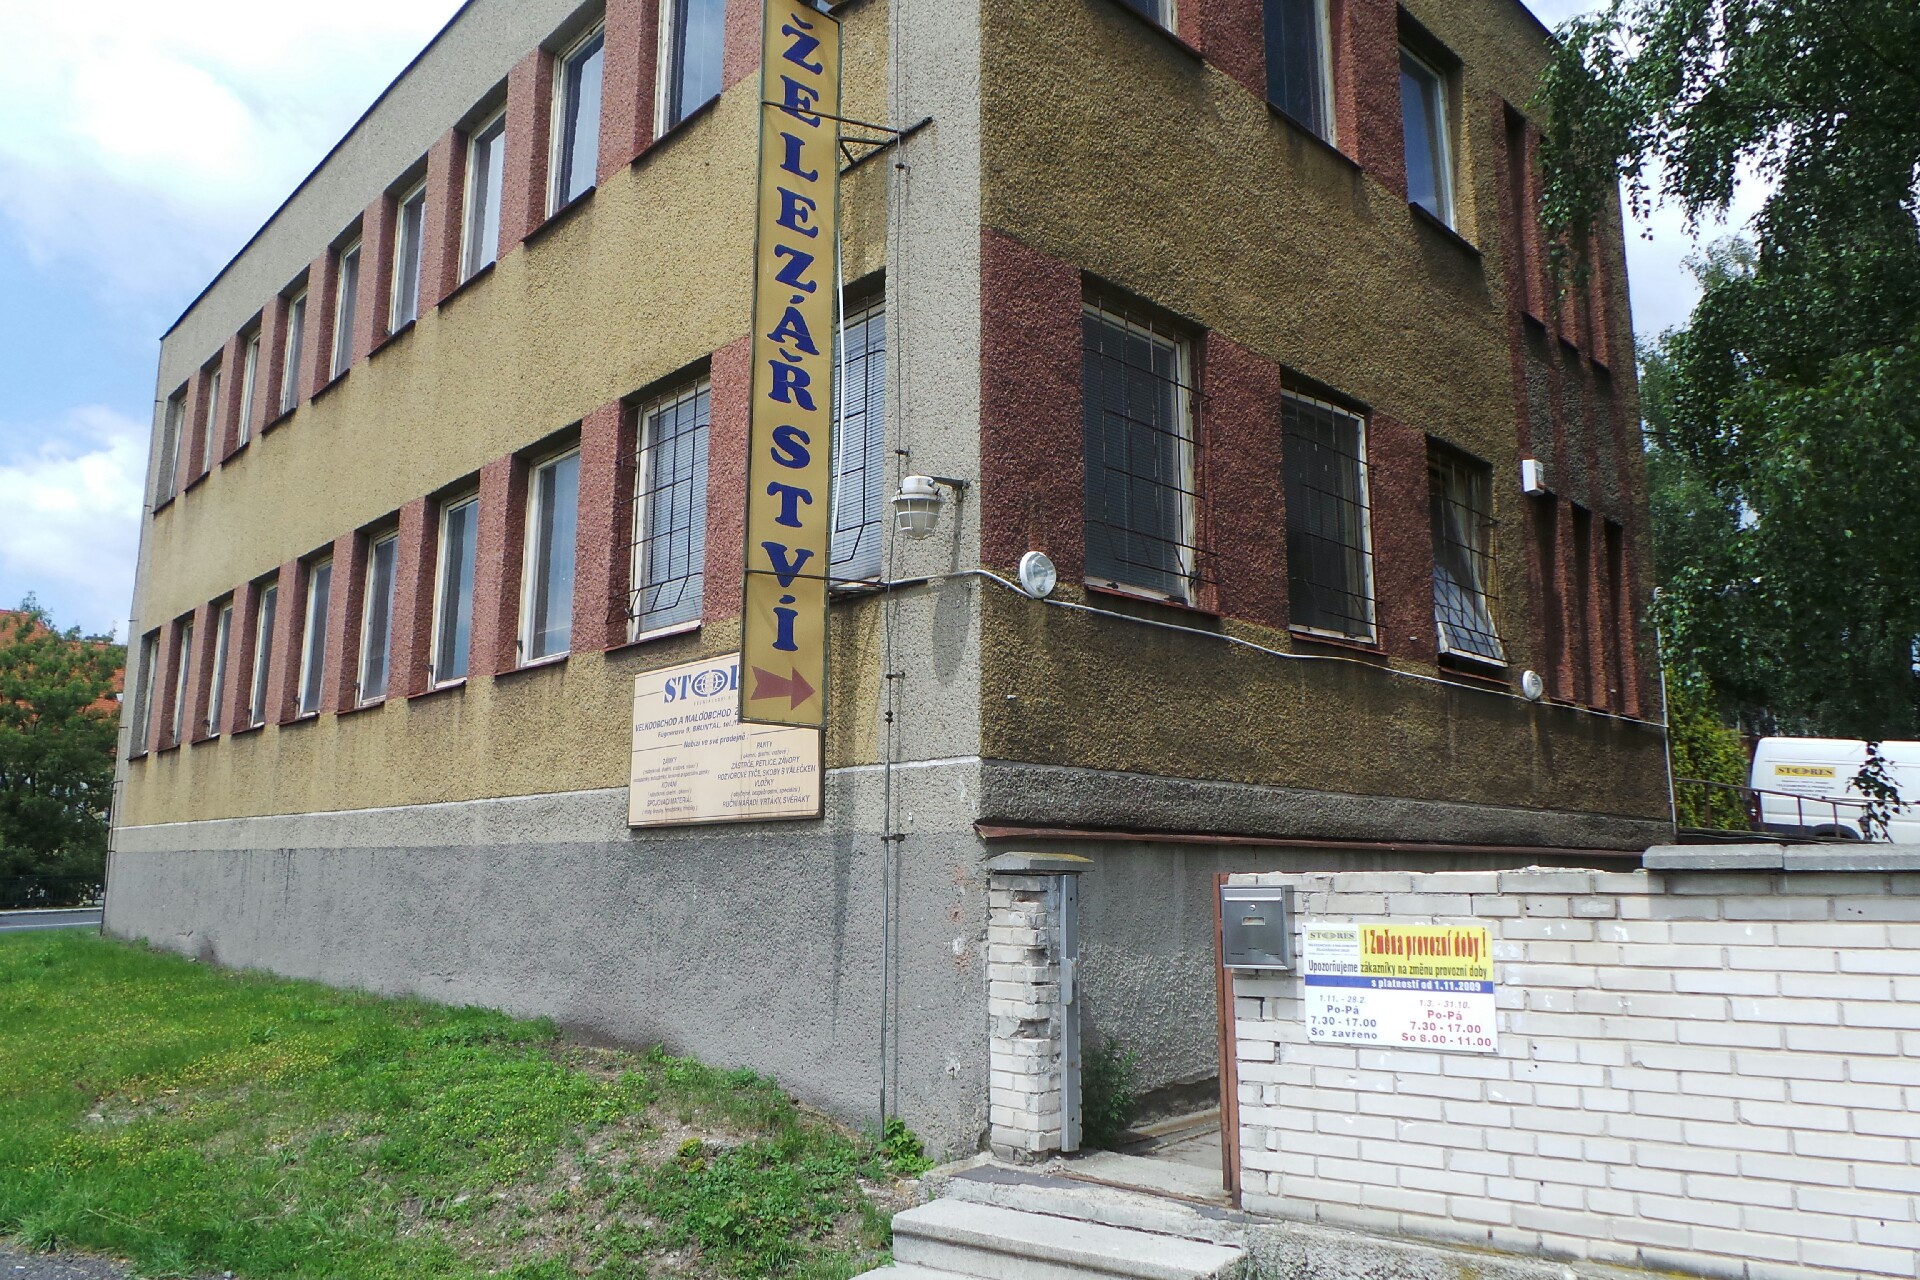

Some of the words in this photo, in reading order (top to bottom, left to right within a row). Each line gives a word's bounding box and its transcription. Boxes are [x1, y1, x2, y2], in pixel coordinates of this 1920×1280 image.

[761, 13, 823, 651] ŽELEZÁŘSTVÍ
[635, 717, 678, 732] VELKOOBCHOD
[678, 716, 684, 725] A
[1370, 929, 1404, 955] Změna
[1406, 930, 1452, 961] provozní
[1454, 931, 1479, 962] doby
[1308, 960, 1358, 974] Upozorňujeme
[1360, 961, 1396, 976] zákazníky
[1398, 965, 1408, 974] na
[1409, 963, 1433, 975] změnu
[1435, 964, 1468, 977] provozní
[1469, 965, 1487, 980] doby
[1378, 978, 1420, 989] platností
[1421, 980, 1432, 989] od
[1434, 981, 1482, 992] 1.11.2009
[1327, 1004, 1360, 1015] Po-Pá
[1443, 1000, 1470, 1009] 31.10.
[1427, 1009, 1463, 1021] Po-Pá
[1310, 1016, 1335, 1026] 7.30
[1346, 1018, 1377, 1028] 17.00
[1409, 1021, 1436, 1032] 7.30
[1447, 1023, 1481, 1034] 17.00
[1311, 1027, 1325, 1037] So
[1332, 1028, 1378, 1040] zavřeno
[1401, 1032, 1416, 1042] So
[1420, 1033, 1446, 1044] 8.00
[1457, 1036, 1492, 1047] 11.00
